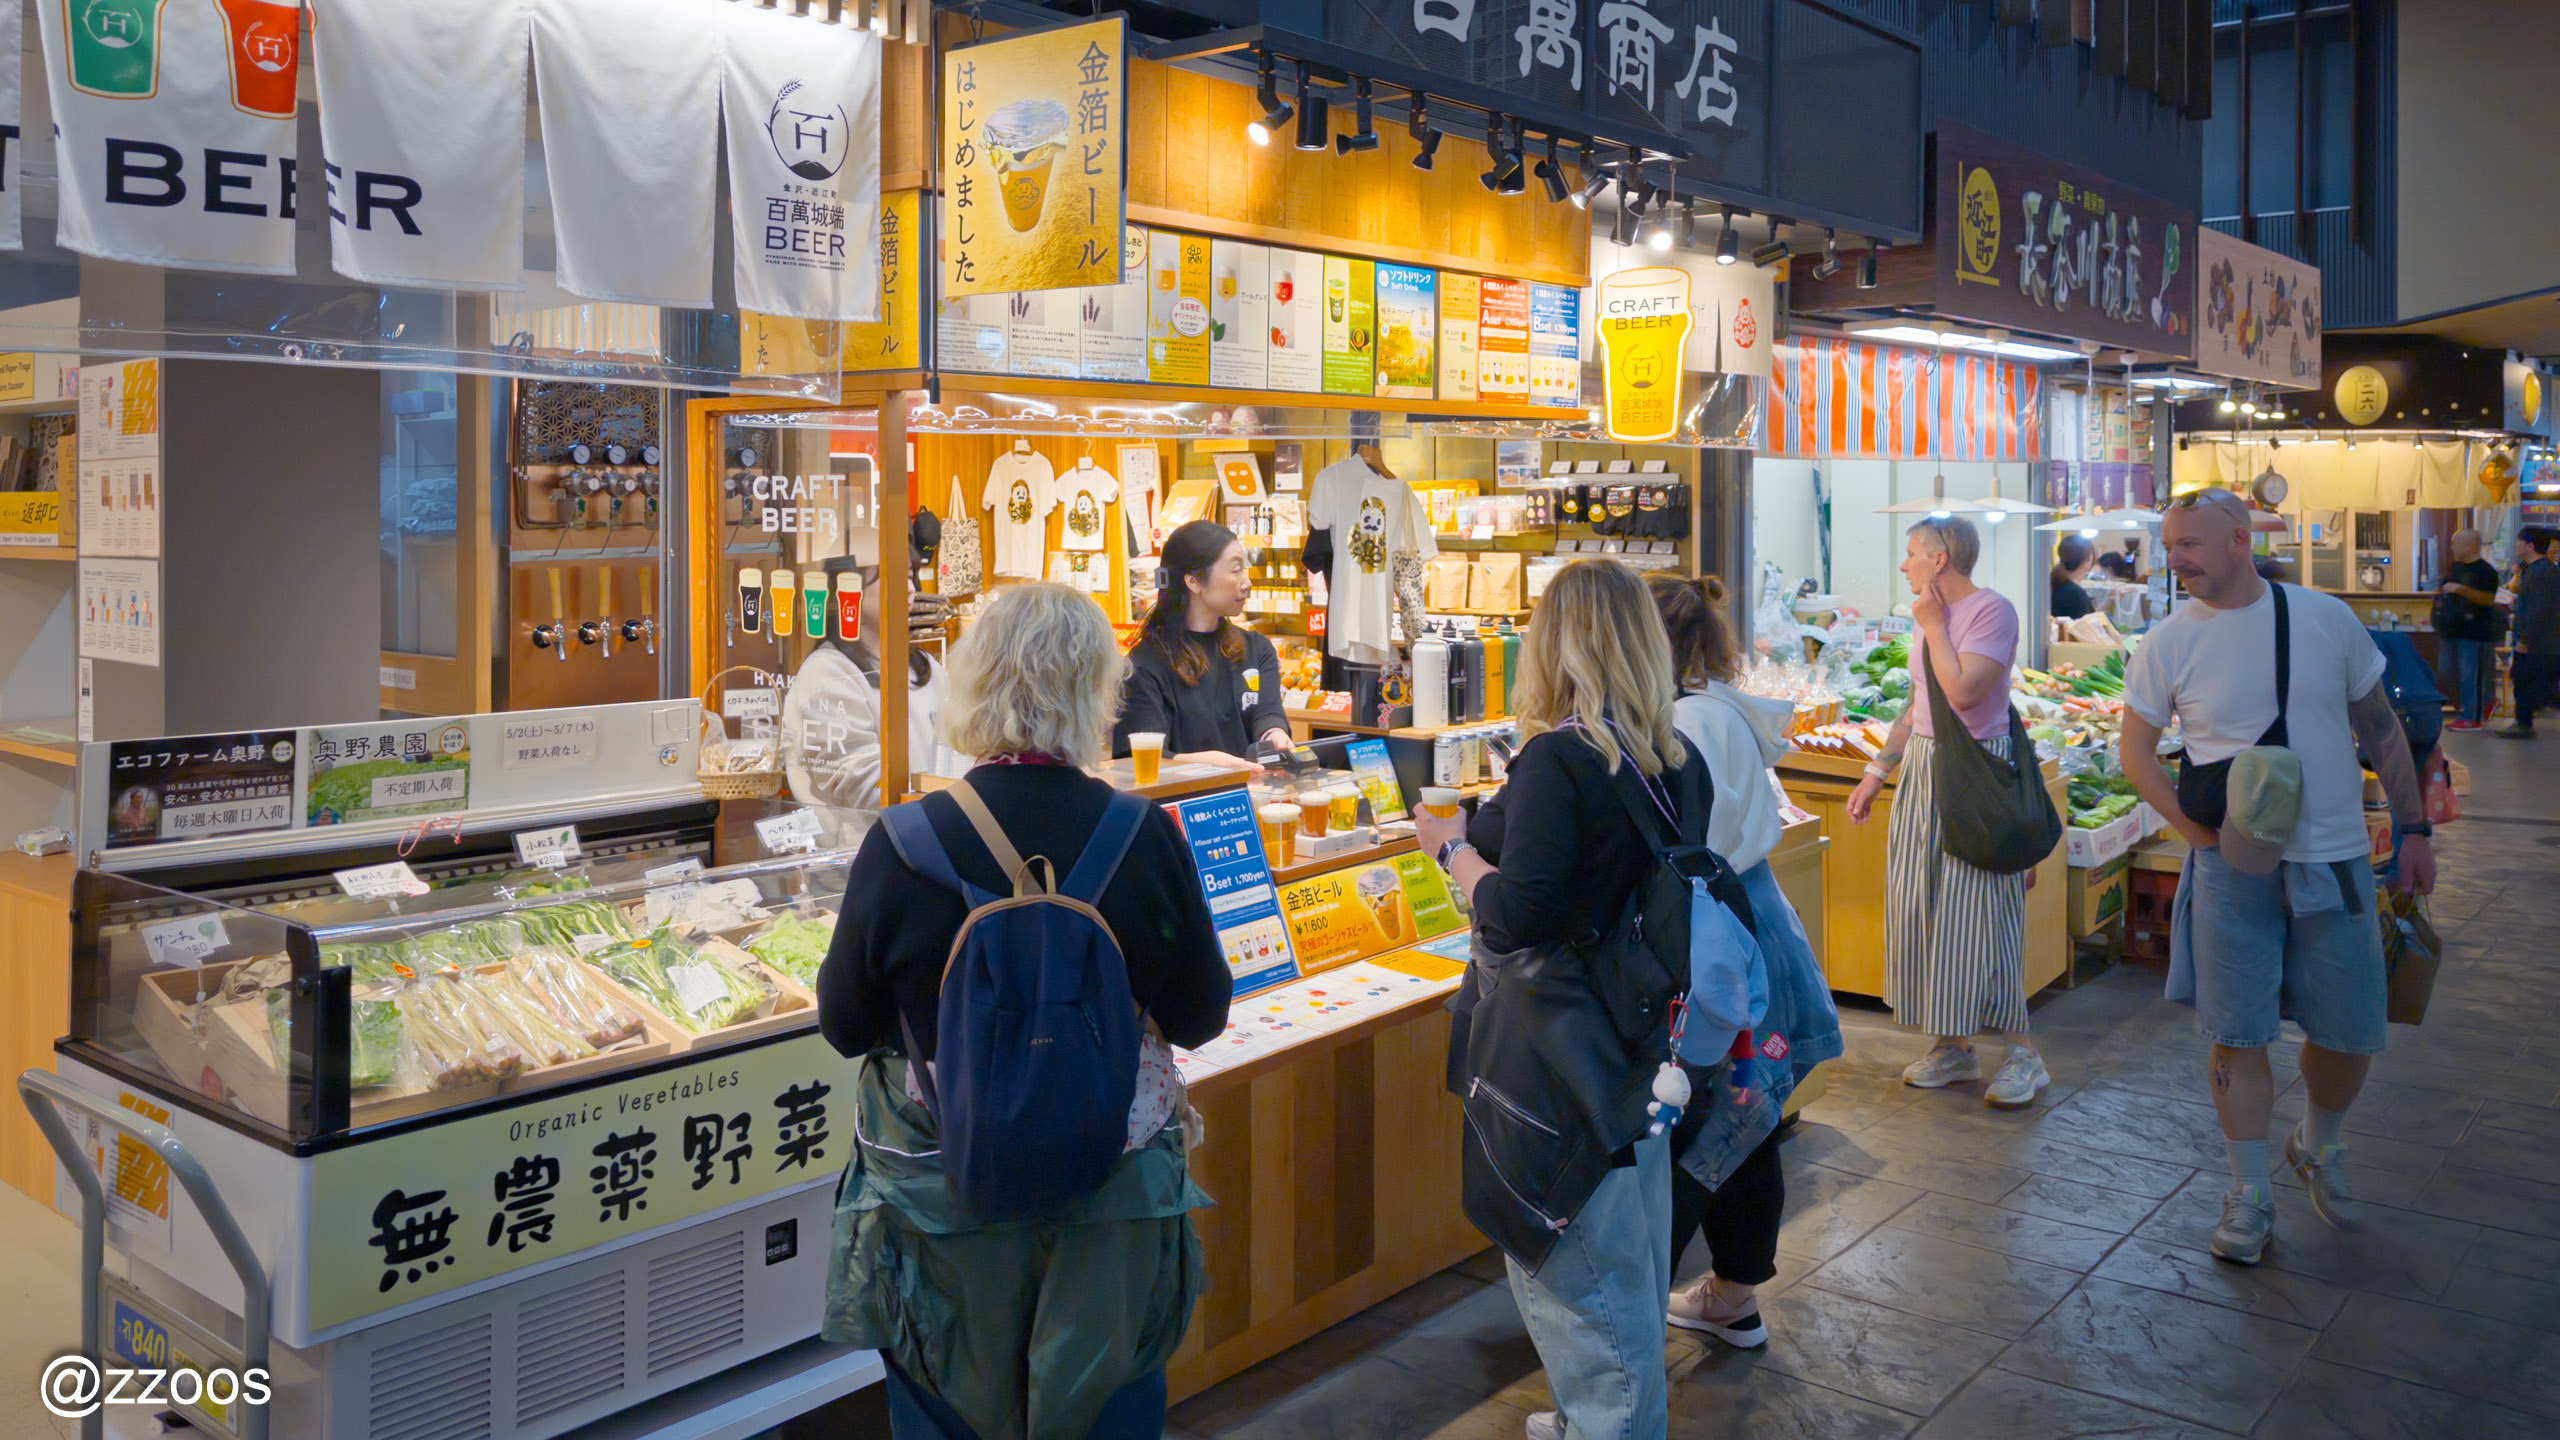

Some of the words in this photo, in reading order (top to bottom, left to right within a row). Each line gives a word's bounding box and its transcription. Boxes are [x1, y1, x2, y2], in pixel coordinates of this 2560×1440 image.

[1077, 40, 1110, 270] 金箔ビール
[955, 60, 977, 284] はじめました
[105, 137, 423, 236] BEER
[766, 197, 845, 230] 百萬城端
[765, 225, 846, 258] BEER
[880, 206, 900, 356] 金箔ビール
[1390, 269, 1432, 284] ソフトドリンク
[1608, 296, 1681, 314] CRAFT
[1615, 314, 1673, 331] BEER
[2360, 384, 2375, 410] 二六
[1620, 411, 1663, 424] BEER
[752, 474, 846, 500] CRAFT
[20, 502, 58, 524] 返却口
[762, 507, 838, 534] BEER
[1321, 695, 1334, 710] 5
[116, 744, 265, 769] エコファーム奥野
[313, 732, 427, 763] 奥野農園
[518, 745, 582, 761] 野菜入荷なし
[164, 783, 290, 805] 安心・安全な無農薬野菜
[383, 777, 453, 798] 不定期入荷
[173, 804, 285, 829] 毎週木曜日入荷
[1188, 803, 1247, 823] 4種飲みくらべセット
[1286, 880, 1342, 911] 金箔ビール
[509, 1102, 603, 1142] Organic
[617, 1069, 741, 1113] Vegetables
[368, 1079, 832, 1293] 無農薬野菜
